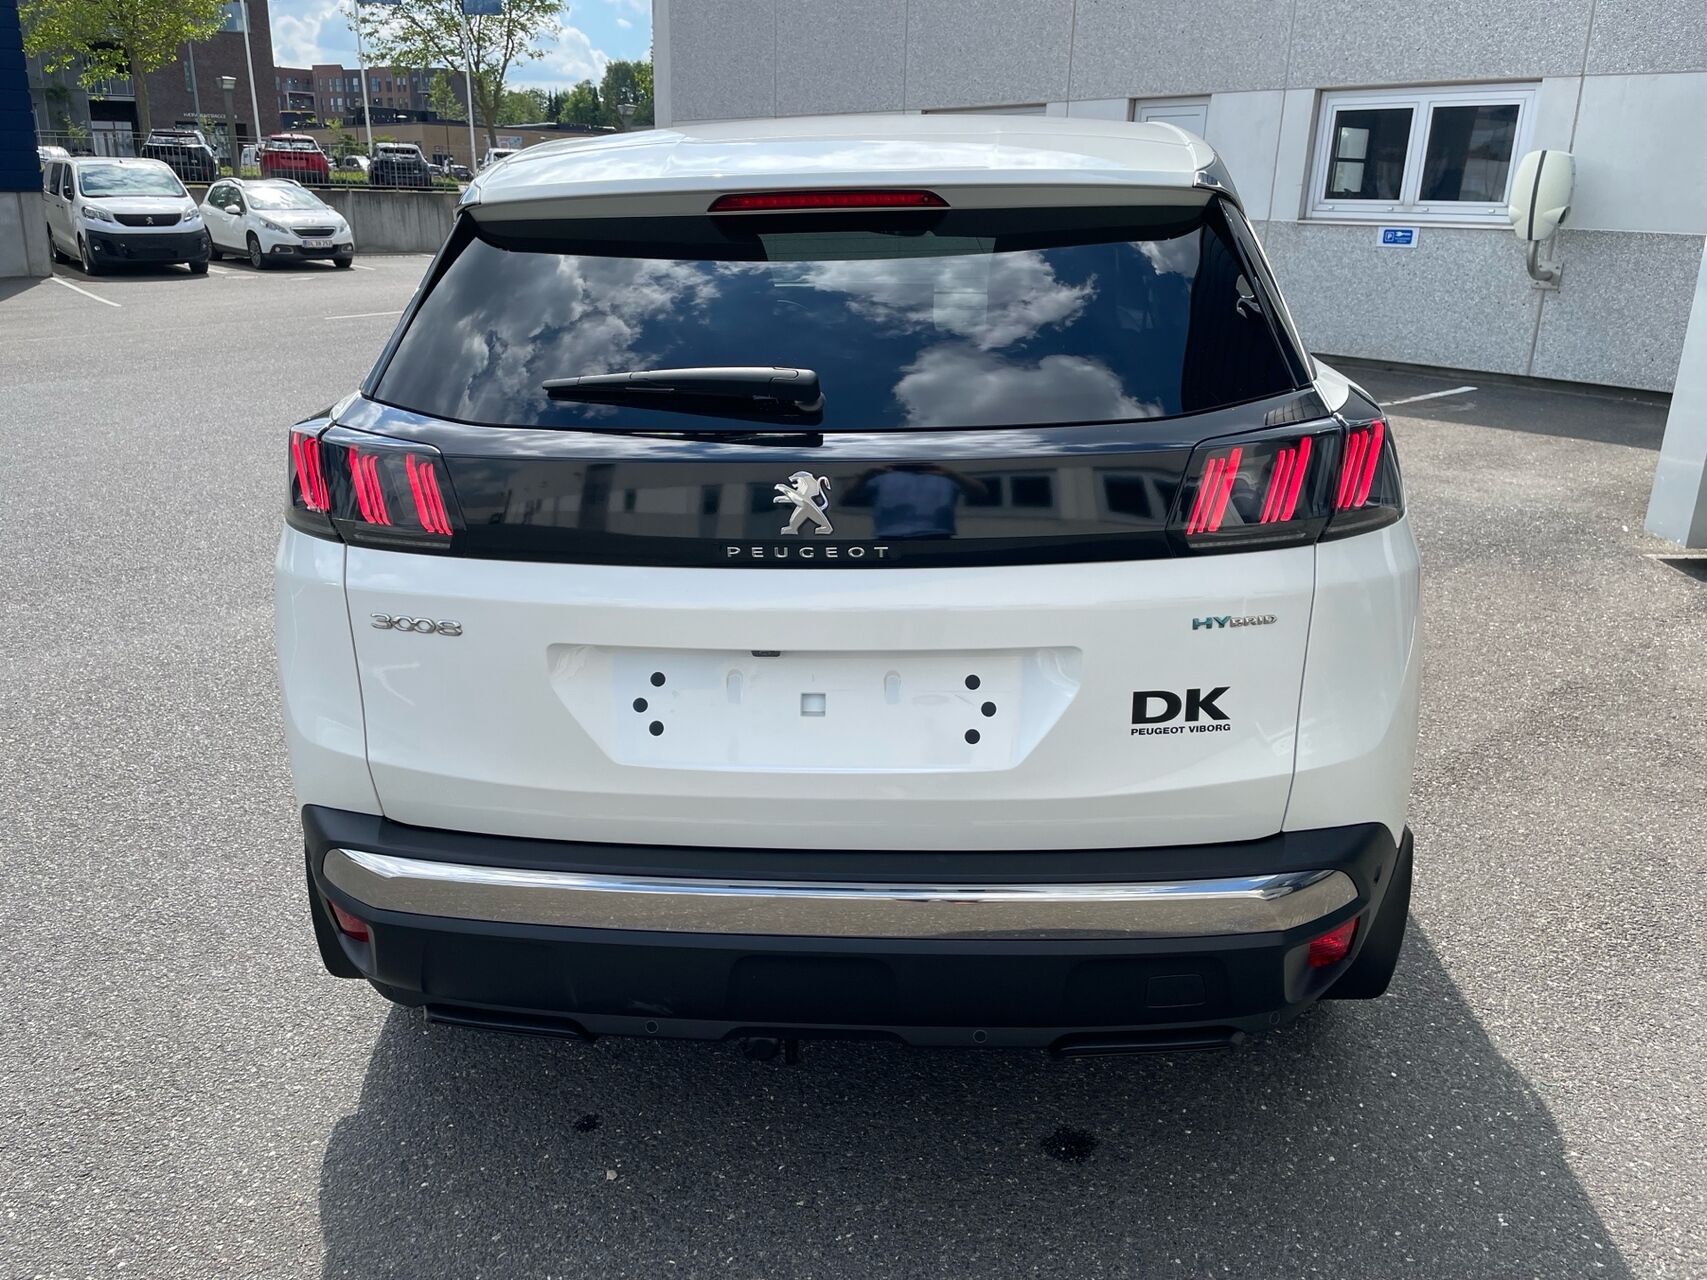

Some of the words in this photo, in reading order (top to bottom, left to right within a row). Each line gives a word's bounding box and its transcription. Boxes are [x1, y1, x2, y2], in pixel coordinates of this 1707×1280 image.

[727, 546, 889, 558] PEUGEOT
[370, 613, 463, 636] 3008
[1192, 614, 1278, 630] HYBRID
[1131, 686, 1231, 724] DK
[1131, 726, 1185, 736] PEUGEOT
[1188, 723, 1231, 733] VIBORG
